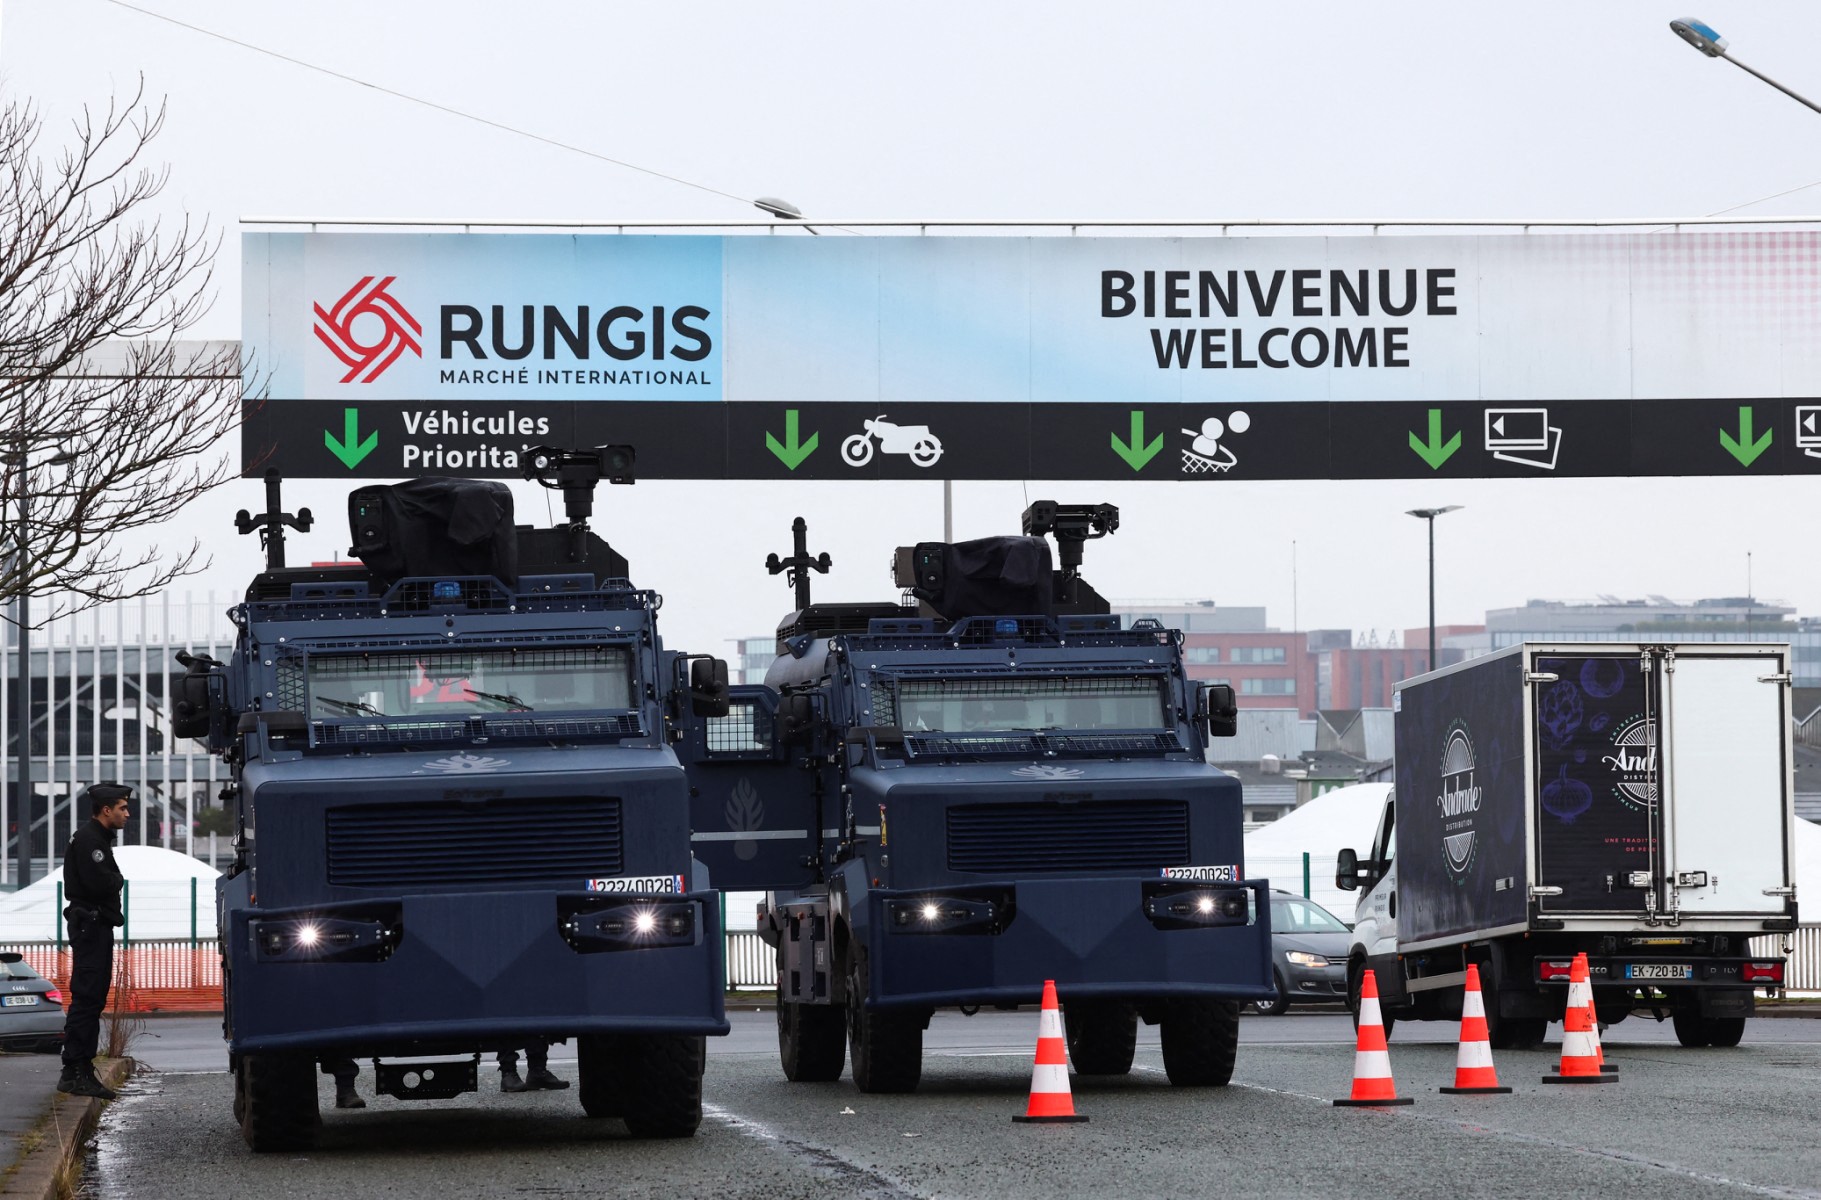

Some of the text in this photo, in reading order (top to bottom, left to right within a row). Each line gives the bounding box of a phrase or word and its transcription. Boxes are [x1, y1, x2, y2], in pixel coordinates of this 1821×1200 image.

[1102, 269, 1456, 317] BIENVENUE
[441, 305, 711, 361] RUNGIS
[1150, 327, 1409, 369] WELCOME
[441, 367, 711, 384] MARCHÉ INTERNATIONAL
[402, 410, 549, 434] Véhicules
[1436, 772, 1482, 818] Andrade
